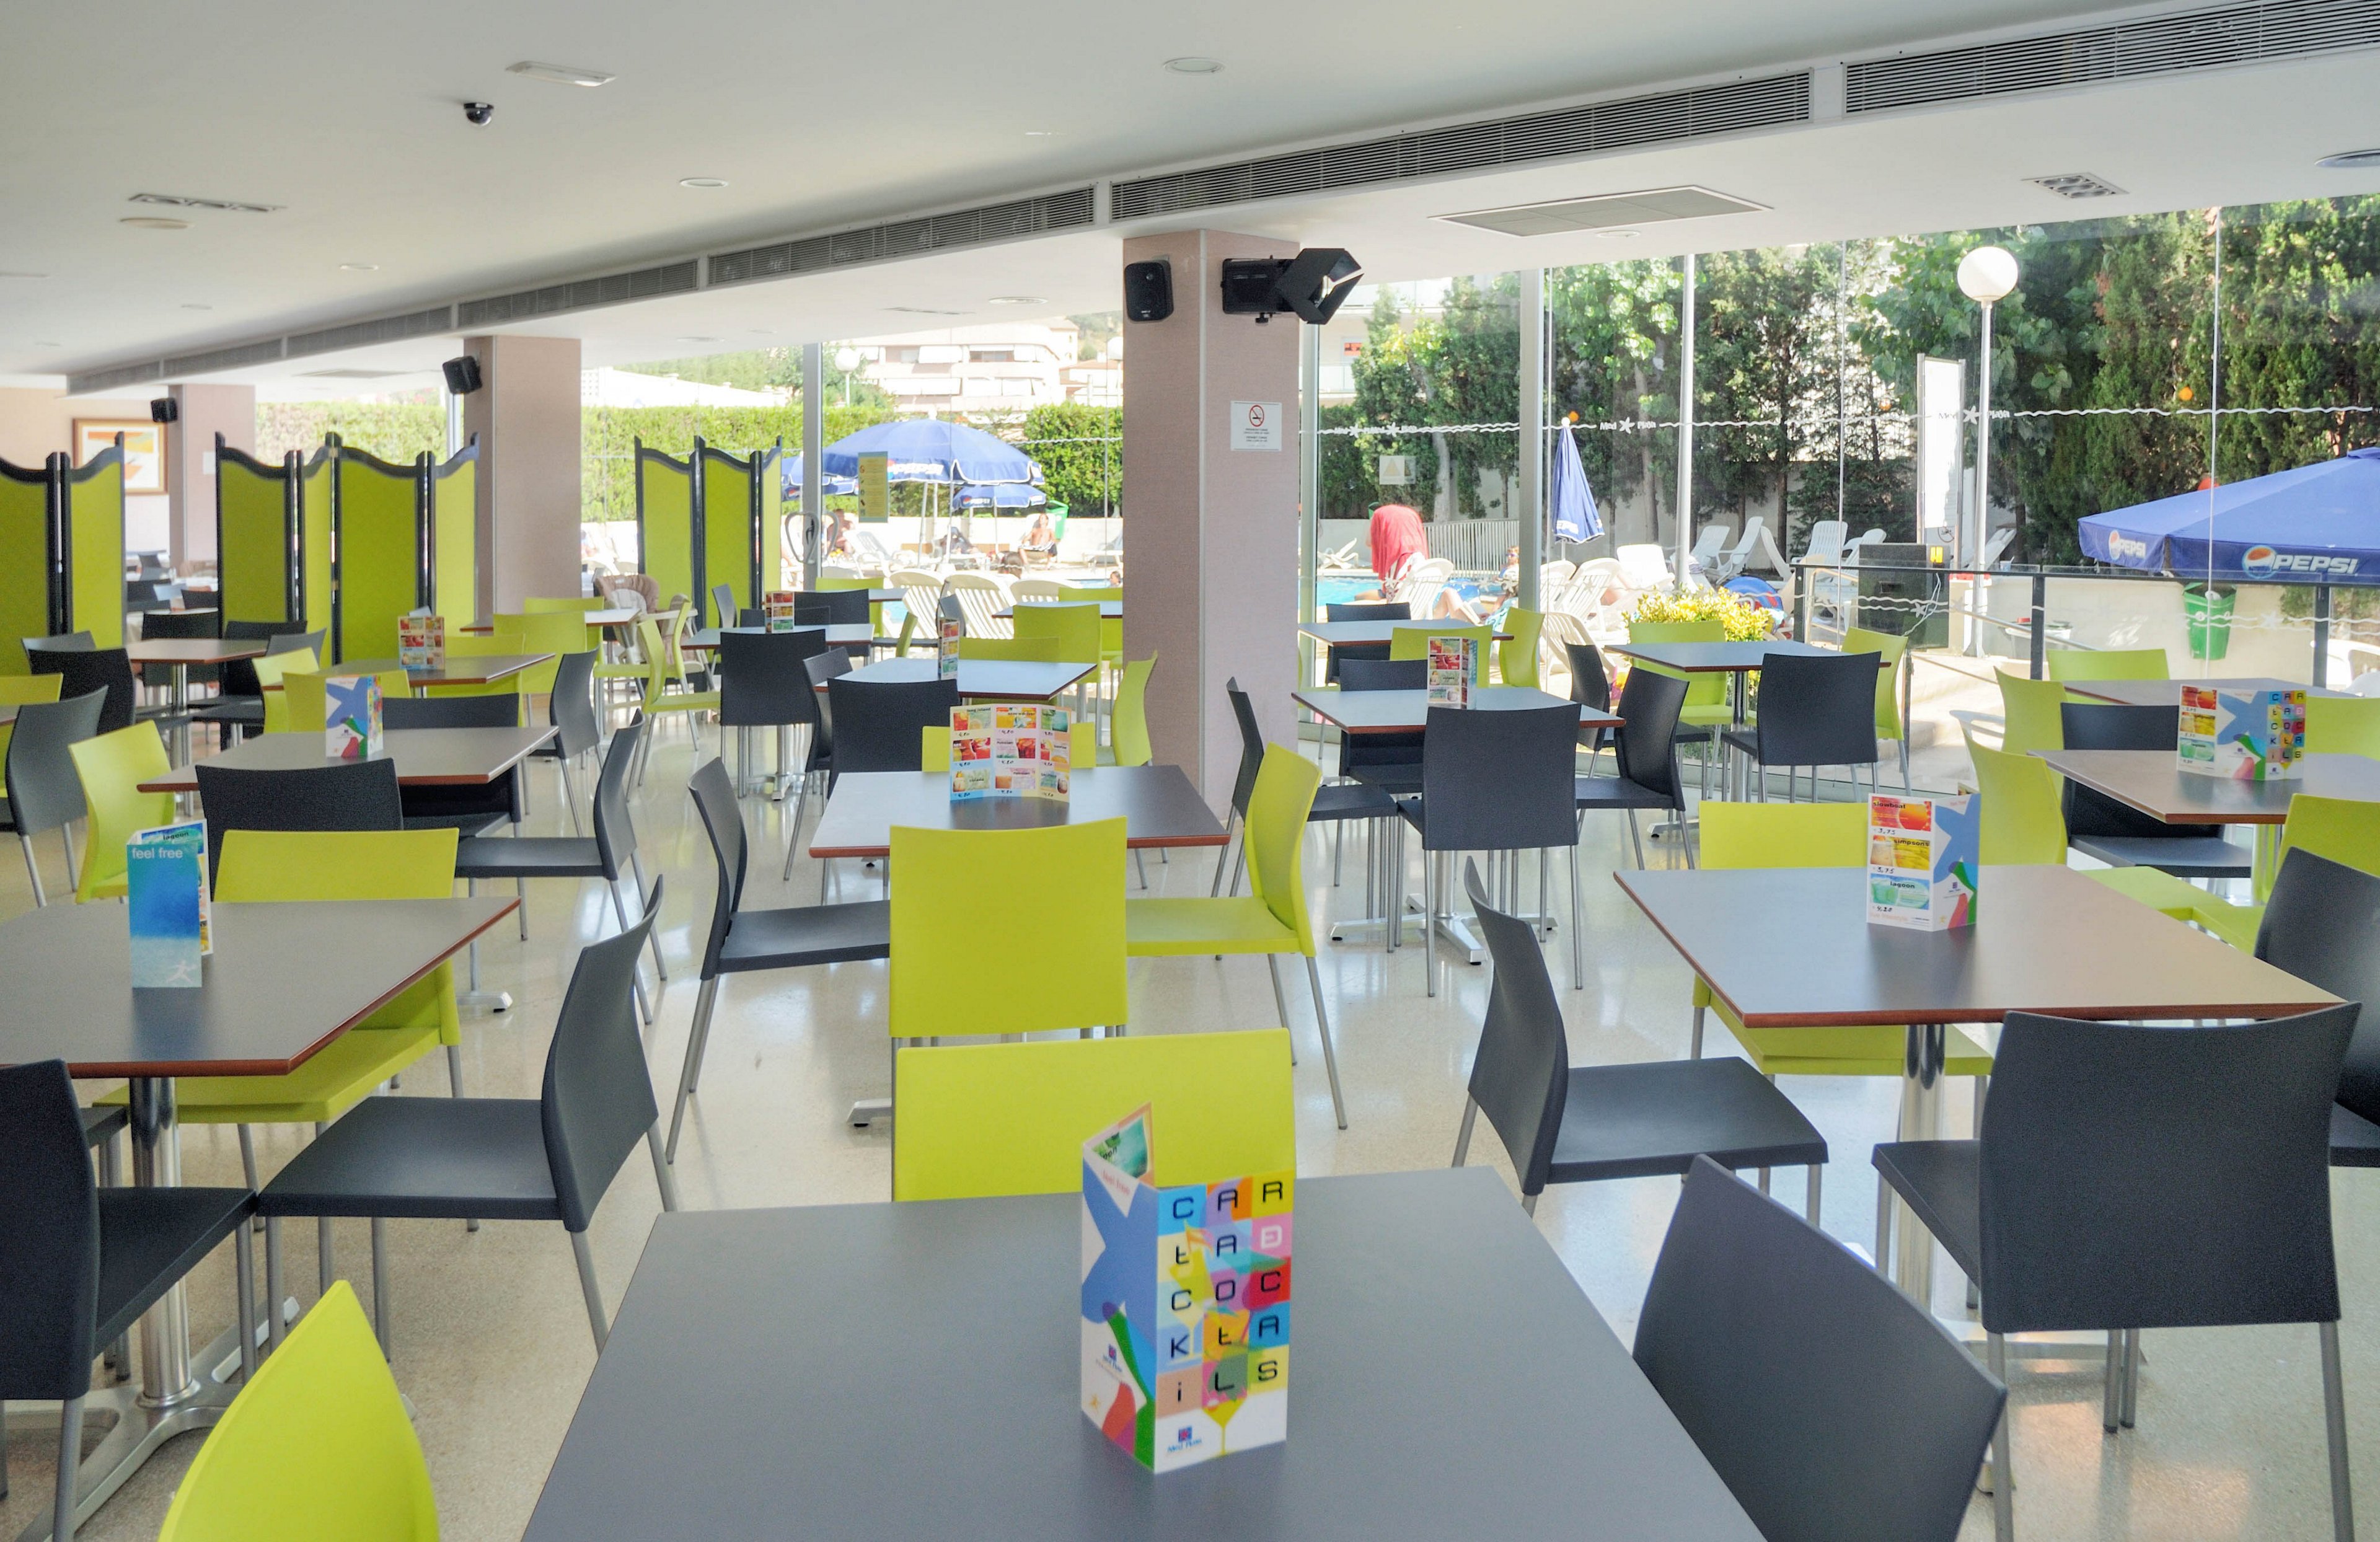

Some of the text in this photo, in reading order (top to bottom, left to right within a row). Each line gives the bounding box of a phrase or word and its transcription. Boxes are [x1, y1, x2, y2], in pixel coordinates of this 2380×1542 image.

[2120, 538, 2146, 558] PEPSI
[2272, 554, 2359, 575] PEPSI
[163, 831, 190, 840] lagoon
[132, 847, 183, 859] feel free
